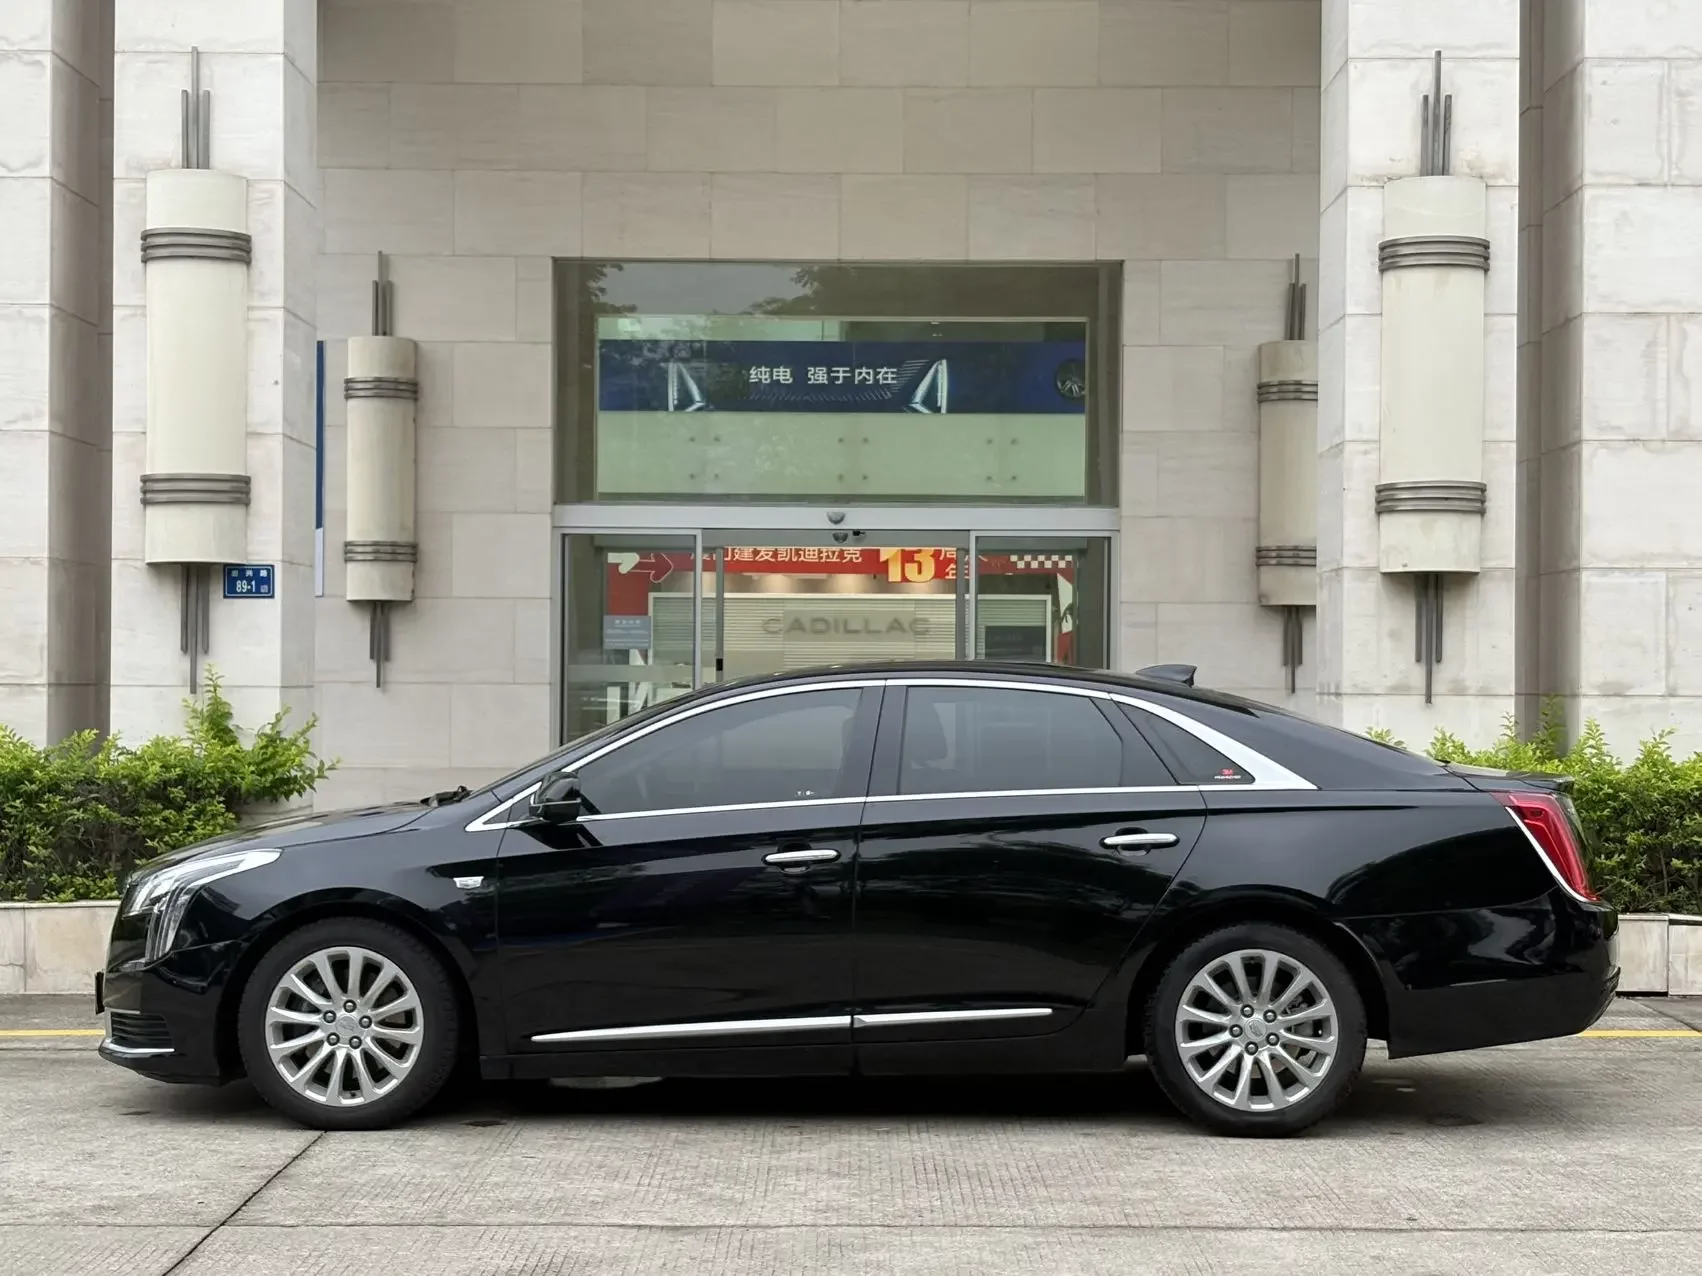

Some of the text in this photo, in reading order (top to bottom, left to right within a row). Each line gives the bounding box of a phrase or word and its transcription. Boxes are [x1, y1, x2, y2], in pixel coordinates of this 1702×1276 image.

[749, 365, 898, 385] 纯电 强于内在
[880, 547, 935, 583] 13
[761, 616, 930, 636] CADILLAC
